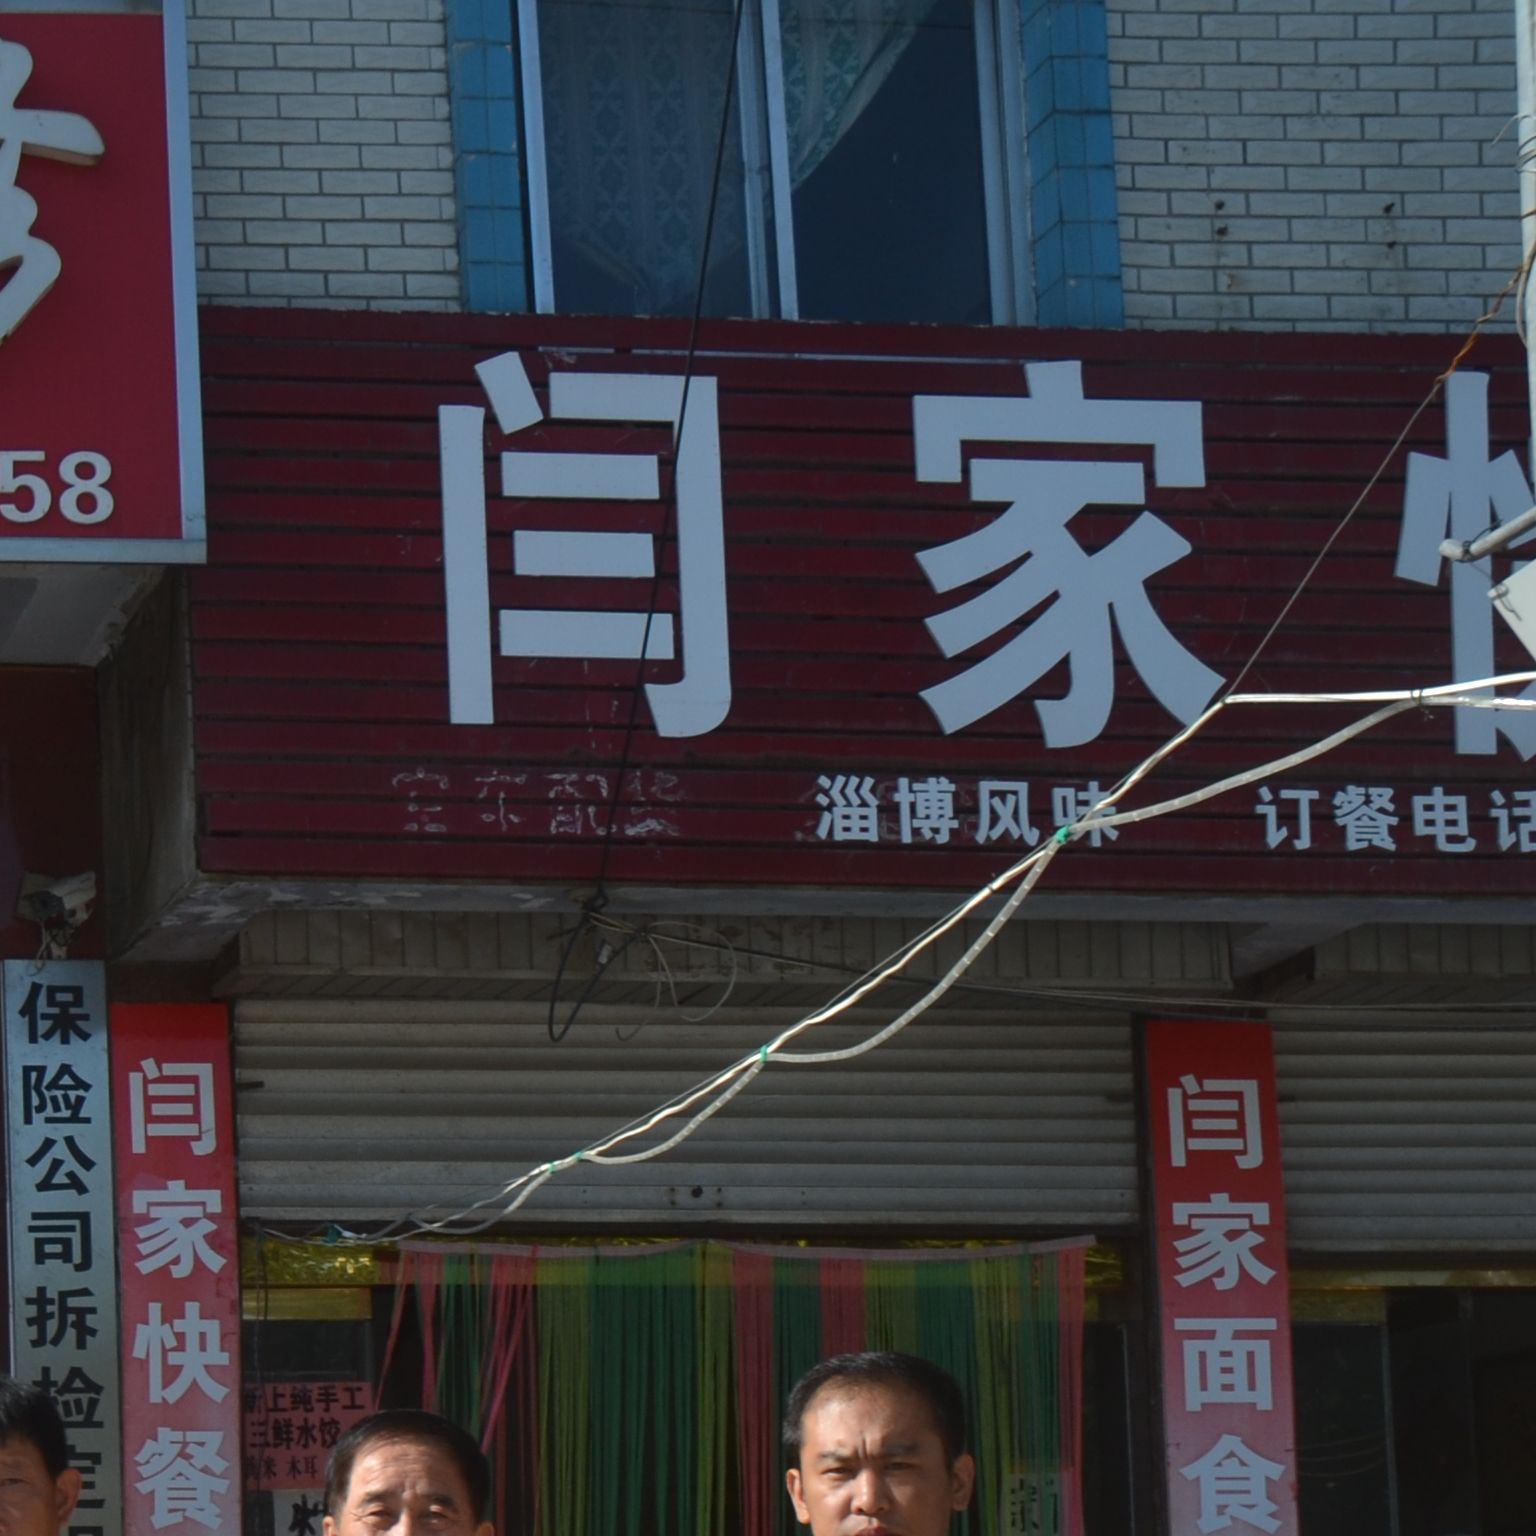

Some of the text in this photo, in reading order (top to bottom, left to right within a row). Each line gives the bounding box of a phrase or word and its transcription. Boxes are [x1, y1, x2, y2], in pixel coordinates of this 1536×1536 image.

[815, 774, 1119, 848] 淄博风味
[249, 1416, 341, 1450] 三鲜水饺
